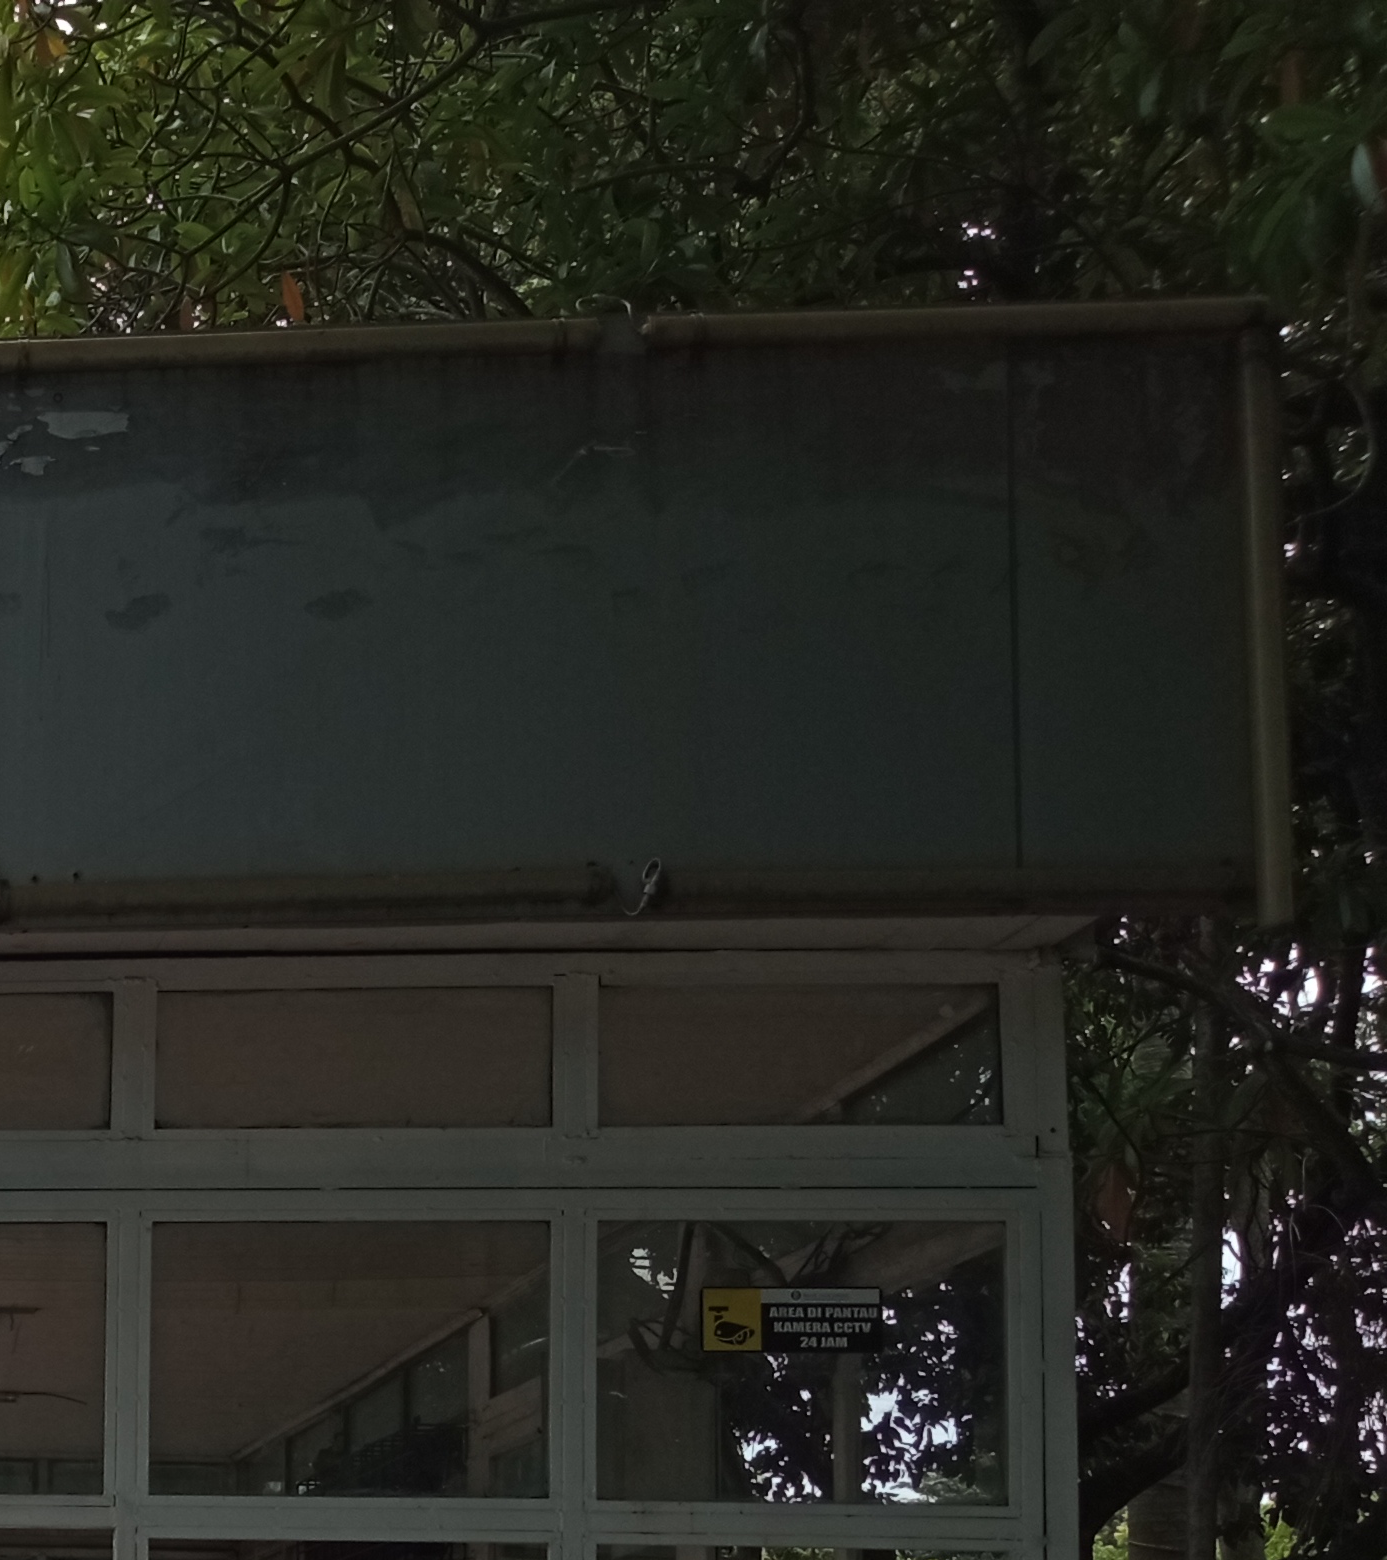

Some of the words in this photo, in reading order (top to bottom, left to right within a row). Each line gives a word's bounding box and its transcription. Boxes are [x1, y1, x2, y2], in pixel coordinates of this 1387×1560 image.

[769, 1306, 805, 1318] AREA
[807, 1306, 822, 1318] DI
[825, 1306, 878, 1318] PANTAU
[773, 1321, 831, 1333] KAMERA
[834, 1322, 872, 1333] CCTV
[800, 1336, 817, 1348] 24
[820, 1336, 848, 1348] JAM
